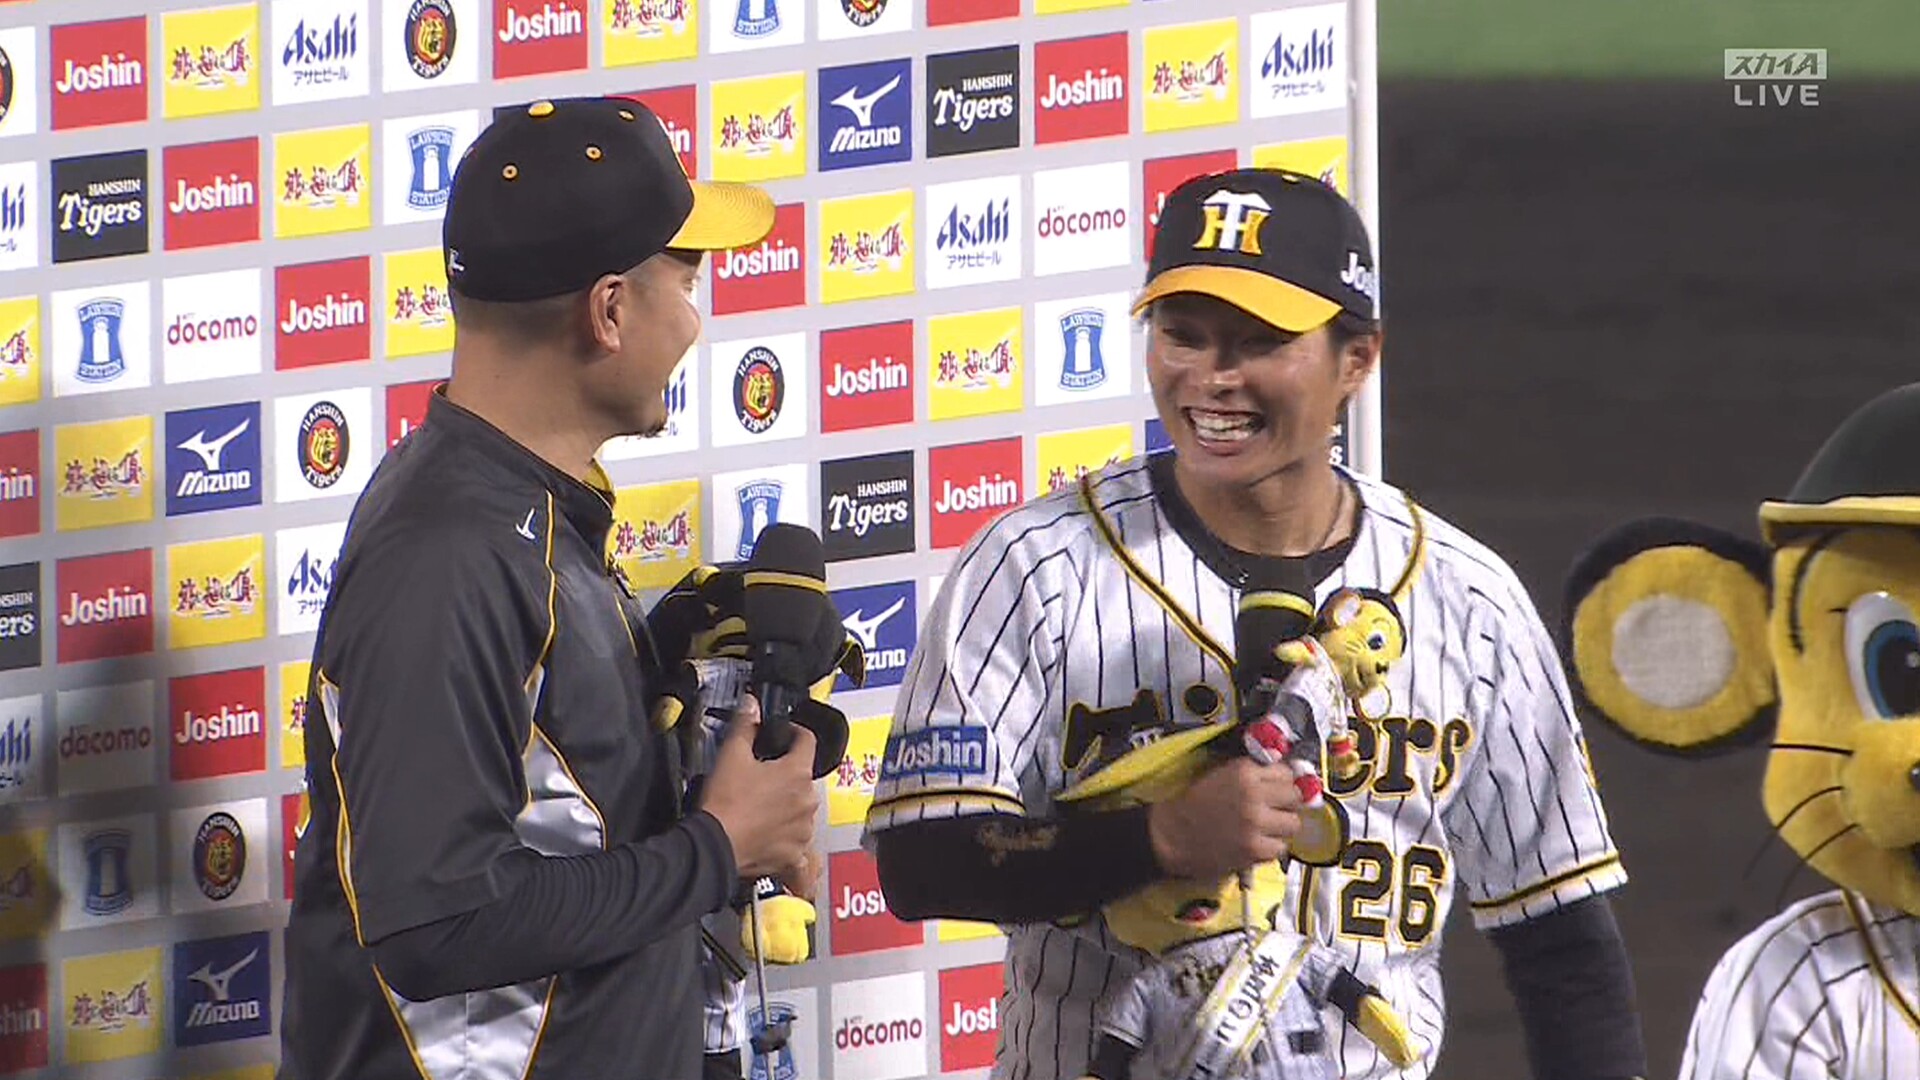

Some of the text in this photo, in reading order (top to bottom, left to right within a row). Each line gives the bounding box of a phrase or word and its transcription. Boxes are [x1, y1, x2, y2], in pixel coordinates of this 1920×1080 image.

[283, 13, 357, 66] Asahi
[499, 2, 582, 43] Joshin
[1261, 26, 1334, 78] Asahi
[56, 53, 142, 94] Joshin
[963, 74, 1013, 91] HANSHIN
[1041, 69, 1123, 109] Joshin
[934, 88, 1013, 131] Tigers
[88, 179, 141, 196] HANSHIN
[168, 174, 254, 214] Joshin
[58, 193, 142, 235] Tigers
[936, 197, 1010, 250] Asahi
[1037, 206, 1126, 238] docomo
[717, 241, 799, 280] Joshin
[167, 314, 258, 345] docomo
[281, 293, 365, 334] Joshin
[738, 351, 780, 378] HANSHIN
[826, 357, 908, 397] Joshin
[740, 410, 778, 434] Tigers
[857, 480, 907, 497] HANSHIN
[935, 473, 1018, 514] Joshin
[828, 492, 908, 535] Tigers
[62, 585, 147, 627] Joshin
[59, 725, 151, 759] docomo
[176, 704, 260, 744] Joshin
[888, 732, 983, 773] Joshin
[1340, 841, 1446, 950] 26
[835, 1017, 923, 1050] docomo
